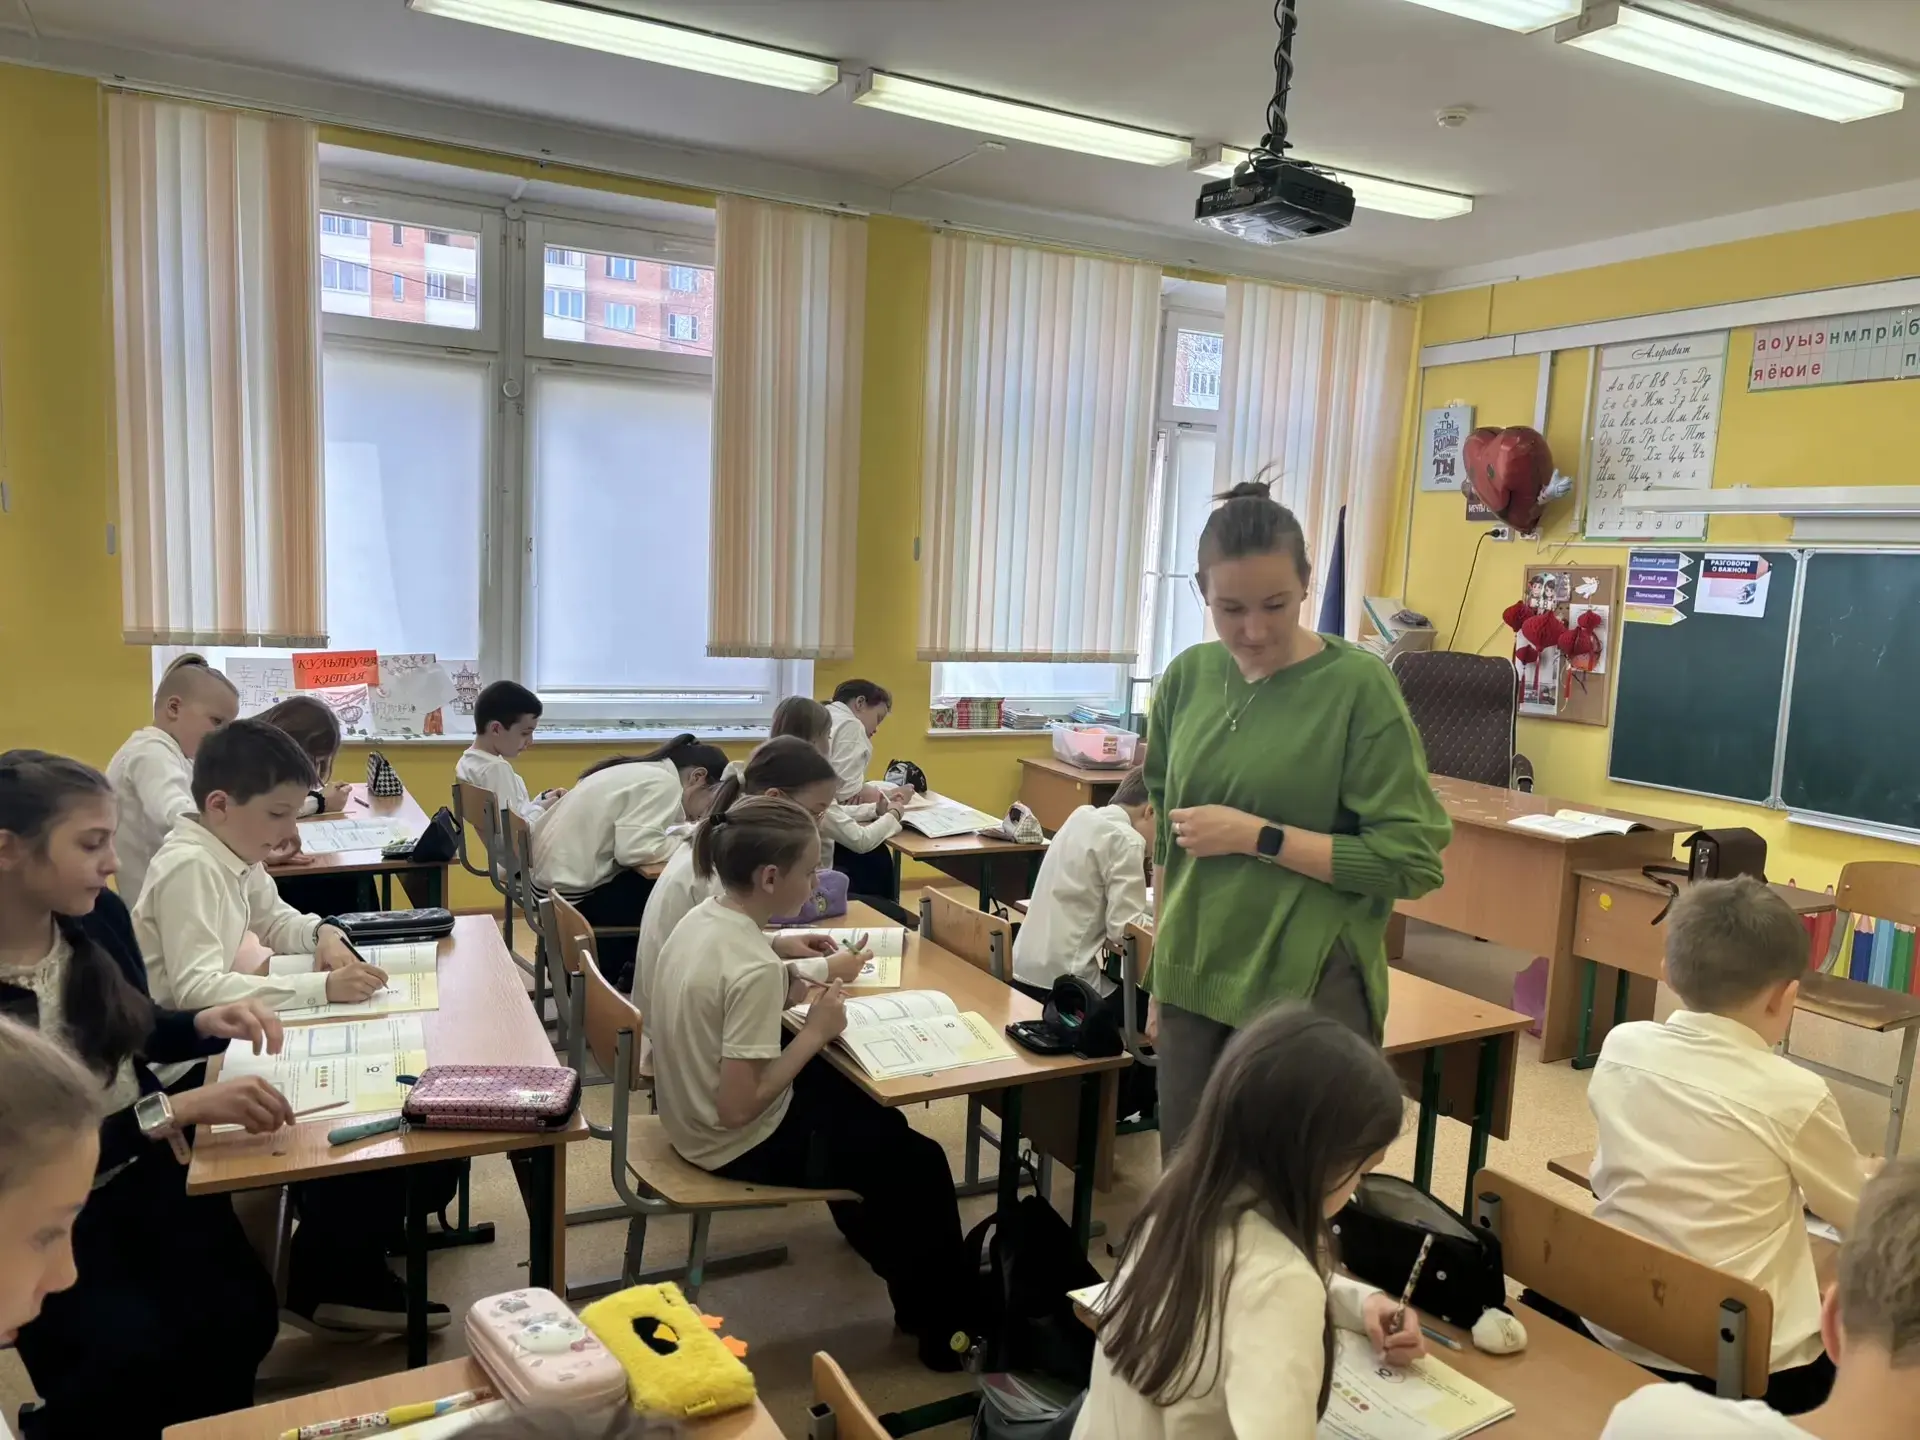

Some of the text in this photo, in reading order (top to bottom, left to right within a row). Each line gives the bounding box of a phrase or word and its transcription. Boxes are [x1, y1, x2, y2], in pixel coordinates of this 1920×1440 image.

[1432, 458, 1455, 476] ТЫ
[1710, 560, 1751, 568] РАЗГОВОРЫ
[1718, 566, 1748, 574] ВАЖНОМ
[296, 655, 377, 670] КУЛЬТУРА
[313, 671, 366, 685] КИТАЯ
